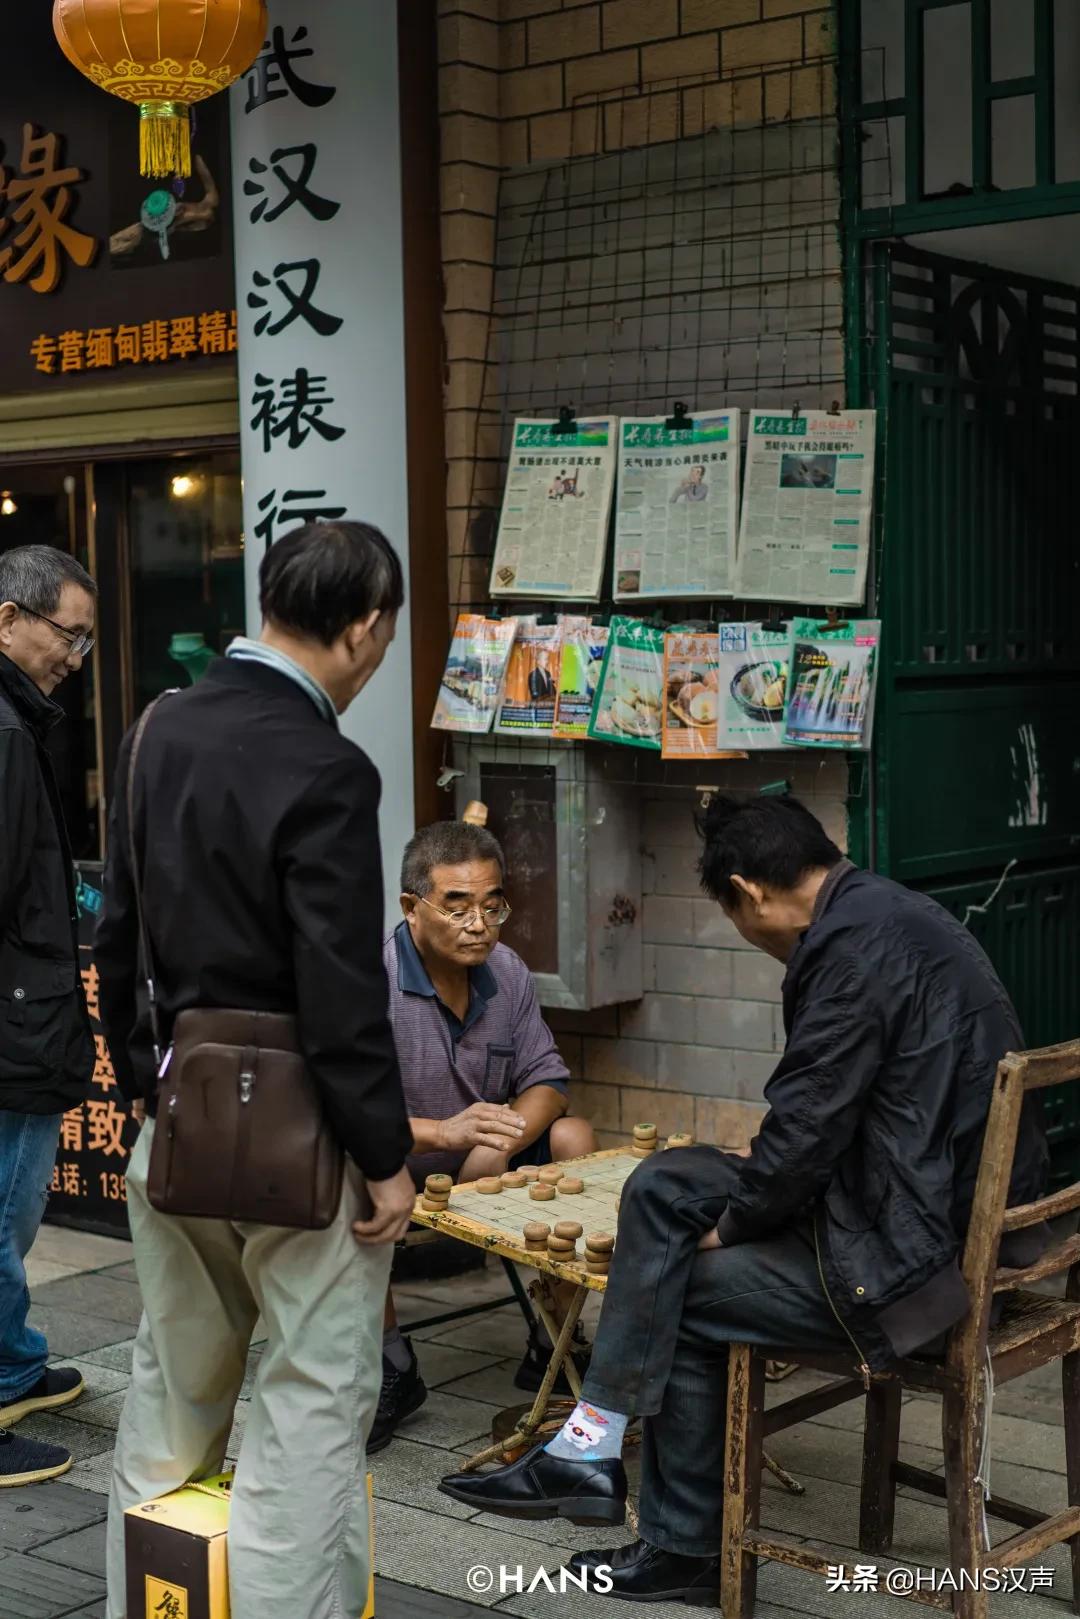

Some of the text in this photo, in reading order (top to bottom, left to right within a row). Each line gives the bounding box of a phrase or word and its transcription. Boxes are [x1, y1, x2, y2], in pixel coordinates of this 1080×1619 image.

[241, 26, 346, 552] 武汉汉裱行
